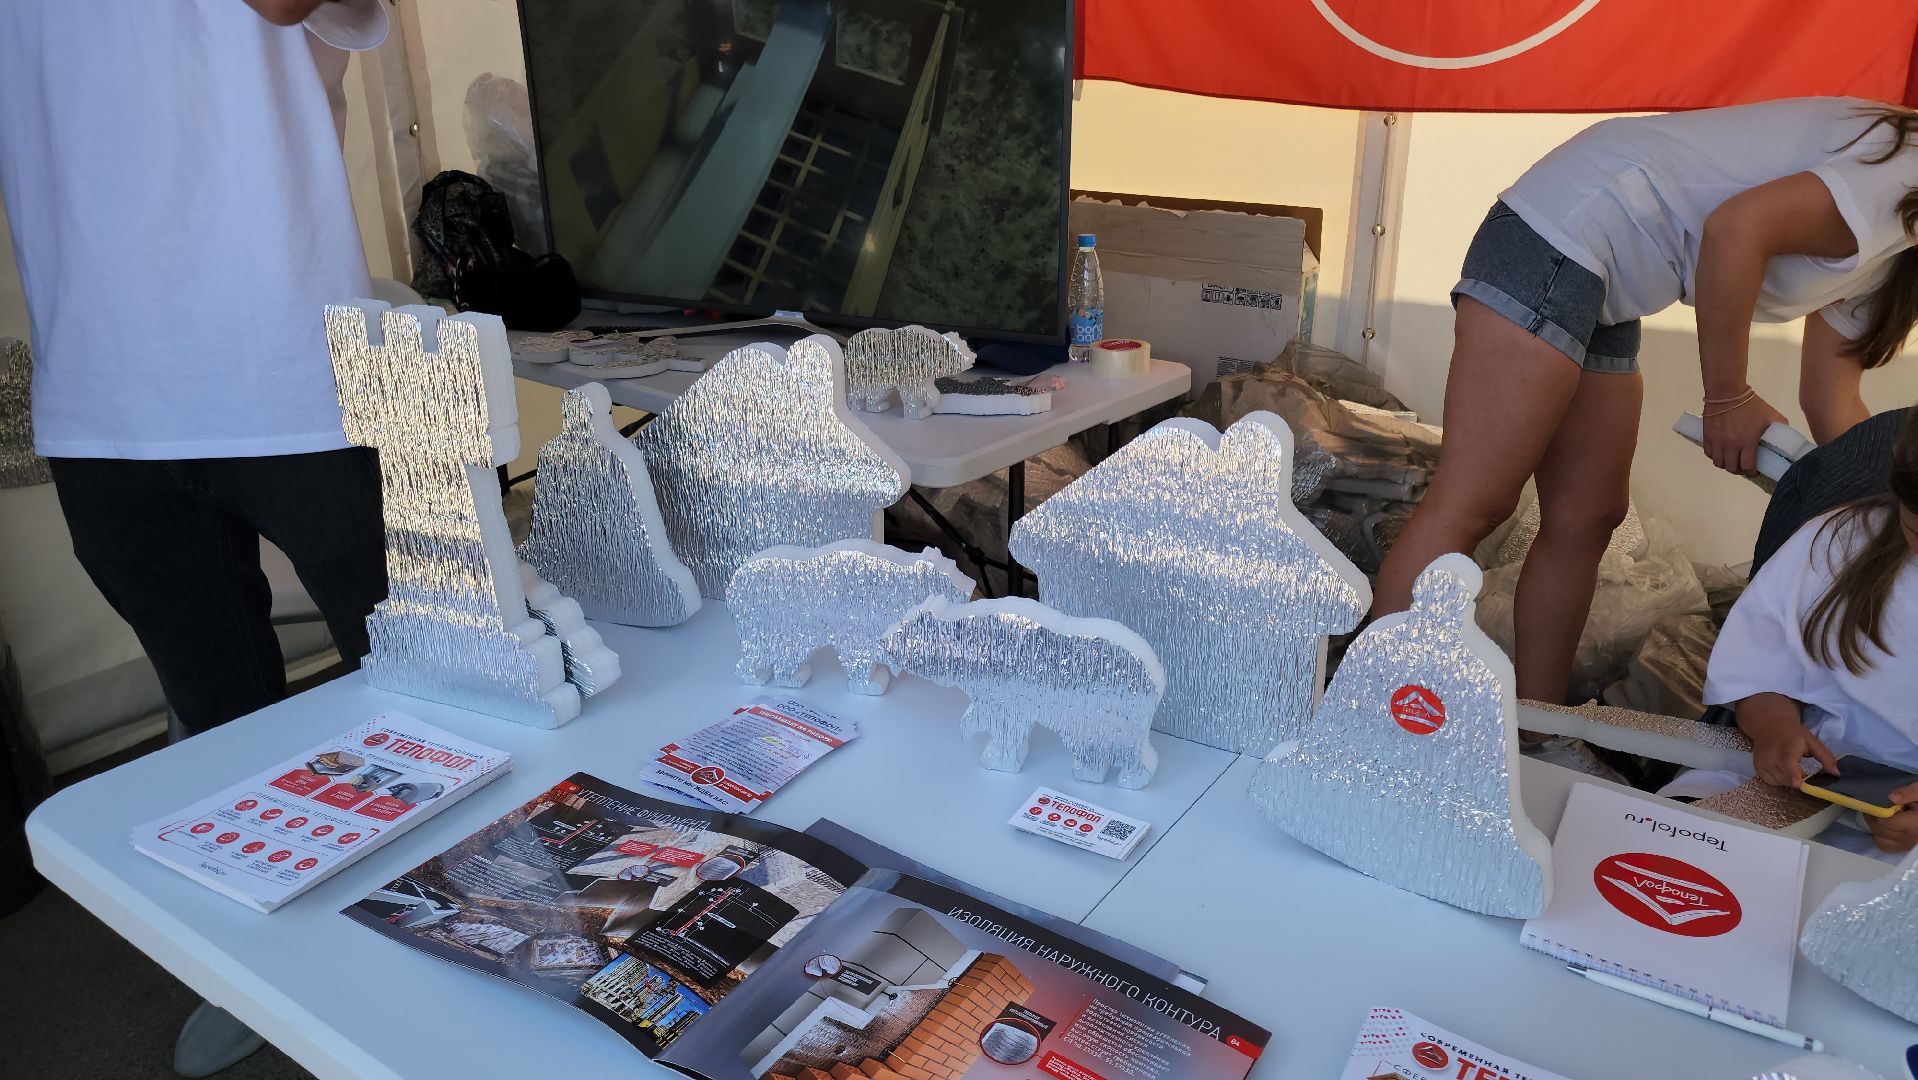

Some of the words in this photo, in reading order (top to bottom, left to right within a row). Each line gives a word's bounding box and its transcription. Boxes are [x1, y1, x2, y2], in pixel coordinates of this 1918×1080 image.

[384, 738, 477, 771] ТЕПОФОЛ
[577, 789, 640, 816] УТЕПЛЕНИЕ
[636, 808, 712, 832] ФУНДАМЕНТА
[1051, 800, 1102, 823] ТЕПОФОЛ
[1624, 813, 1728, 852] Tepofol.ru
[947, 906, 1036, 951] ИЗОЛЯЦИЯ
[1035, 944, 1141, 999] НАРУЖНОГО
[1142, 992, 1222, 1041] КОНТУРА
[1420, 1032, 1509, 1075] СОВРЕМЕННАЯ
